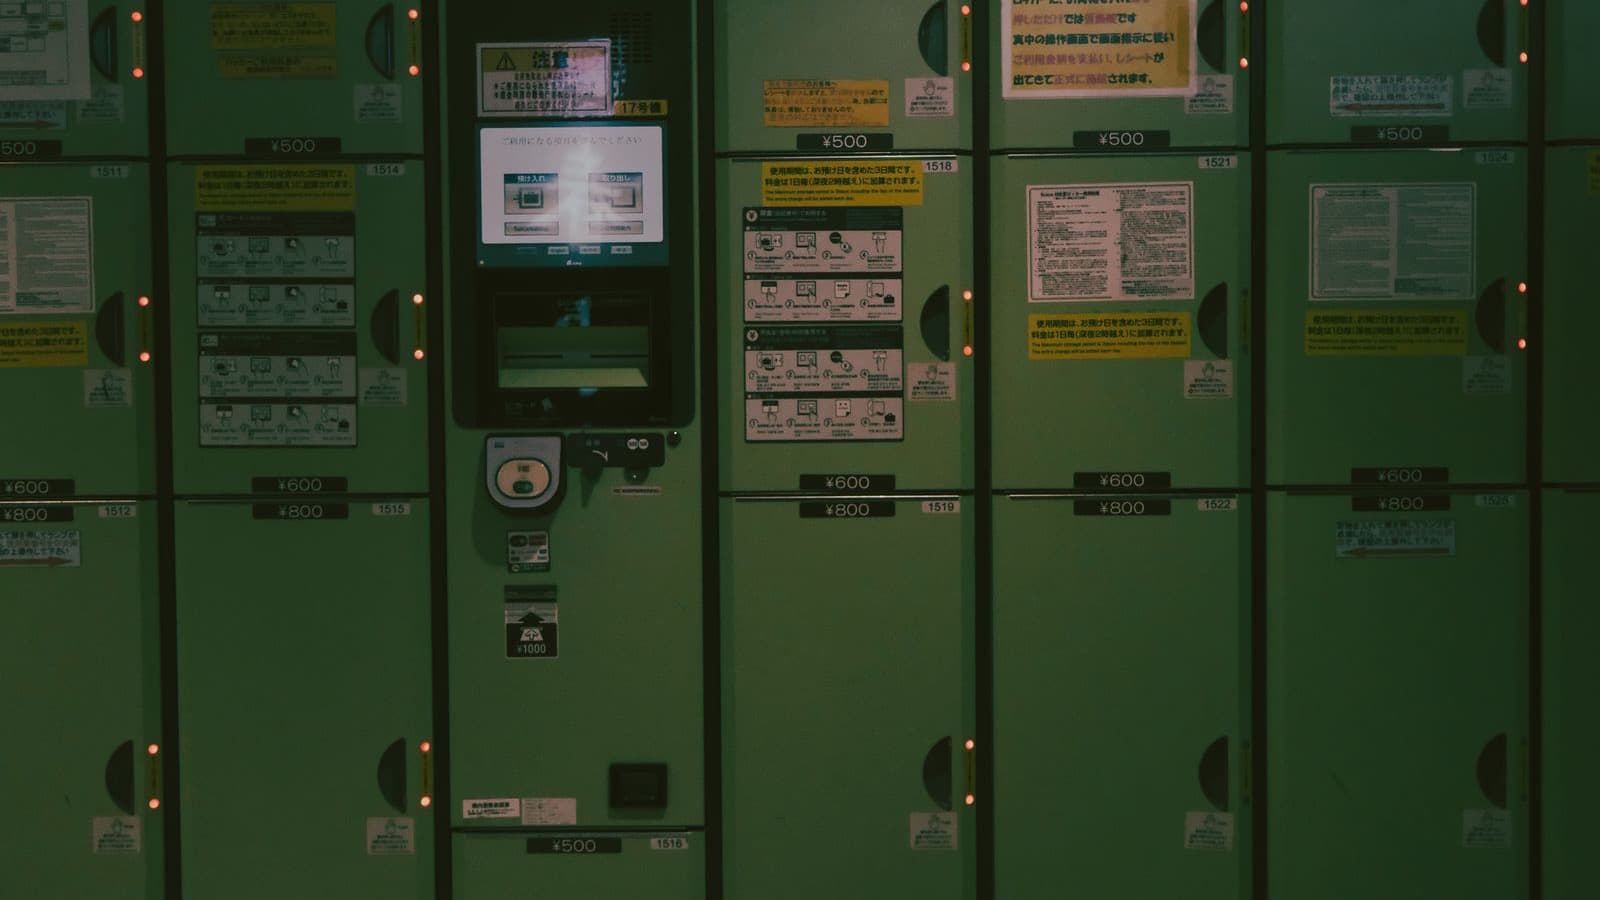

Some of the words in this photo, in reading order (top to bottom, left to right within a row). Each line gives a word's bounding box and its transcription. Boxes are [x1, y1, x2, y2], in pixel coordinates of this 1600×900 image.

[1099, 132, 1144, 145] ¥500
[1377, 127, 1423, 140] ¥500
[271, 139, 316, 152] ¥500
[823, 135, 868, 148] ¥500
[926, 161, 952, 171] 1518
[1205, 158, 1231, 167] 1521
[97, 167, 122, 177] 1511
[373, 165, 399, 175] 1514
[1099, 474, 1145, 487] ¥600
[1377, 469, 1423, 482] ¥600
[5, 480, 49, 494] ¥600
[279, 478, 322, 491] ¥600
[826, 476, 870, 489] ¥600
[379, 504, 405, 514] 1515
[825, 503, 870, 516] ¥800
[928, 502, 954, 512] 1519
[1099, 501, 1145, 515] ¥800
[1205, 499, 1231, 509] 1522
[1377, 496, 1424, 510] ¥800
[4, 508, 48, 521] ¥800
[106, 506, 131, 516] 1512
[279, 505, 323, 518] ¥800
[551, 839, 596, 852] ¥500
[657, 839, 682, 848] 1516
